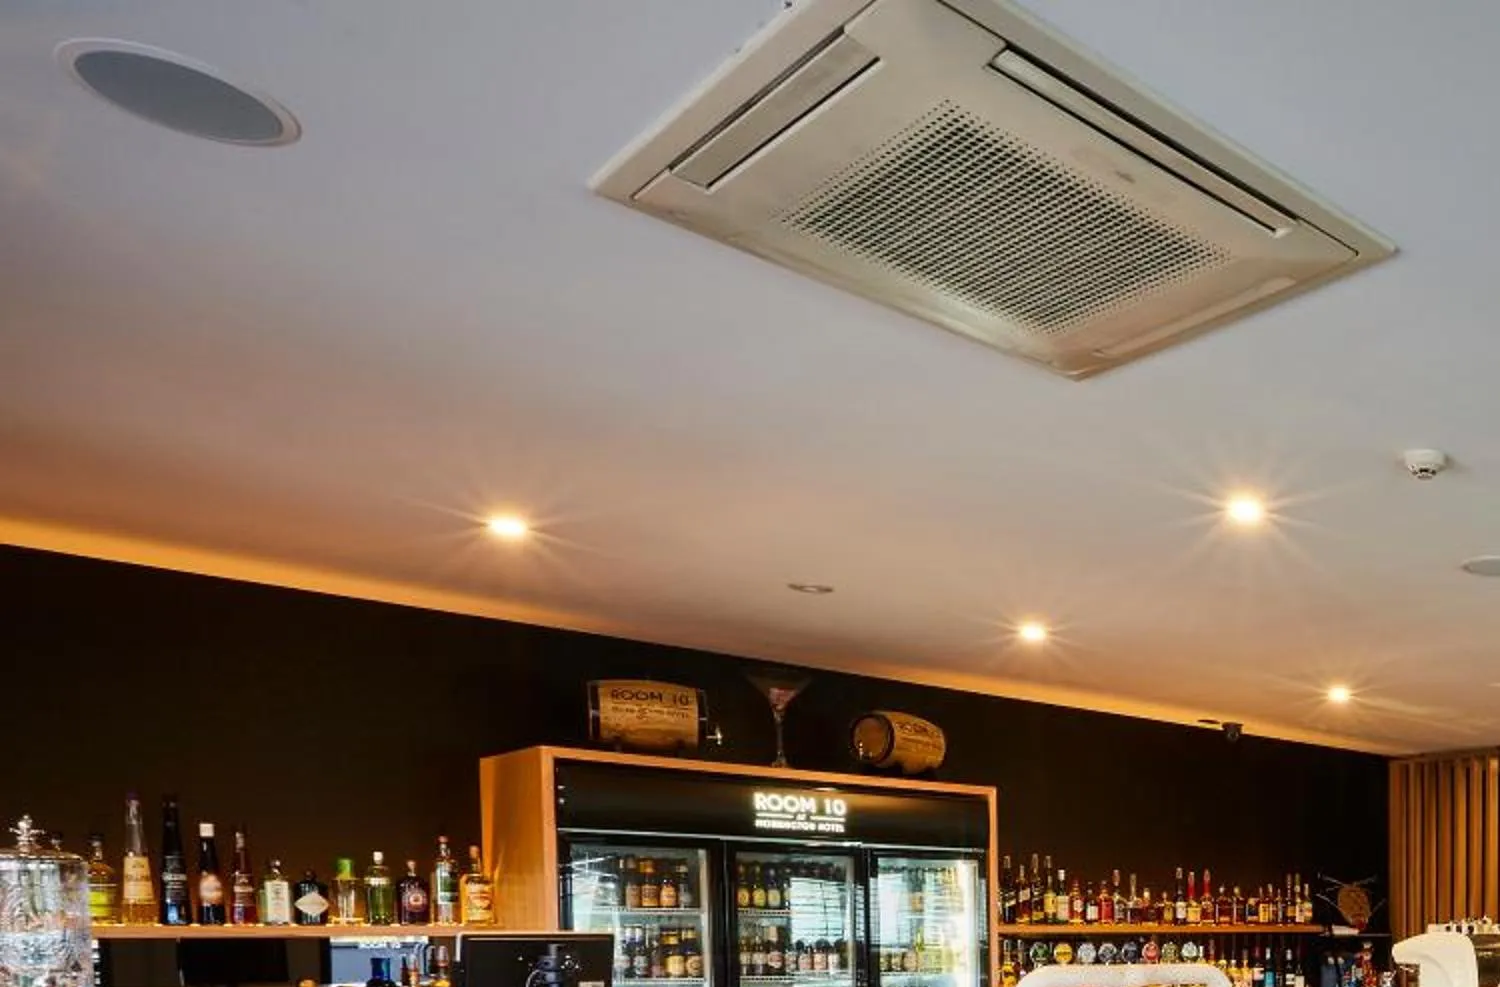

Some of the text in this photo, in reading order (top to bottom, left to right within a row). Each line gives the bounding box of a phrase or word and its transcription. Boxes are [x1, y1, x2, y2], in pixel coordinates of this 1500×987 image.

[611, 688, 690, 706] ROOM 10
[753, 791, 847, 816] ROOM 10
